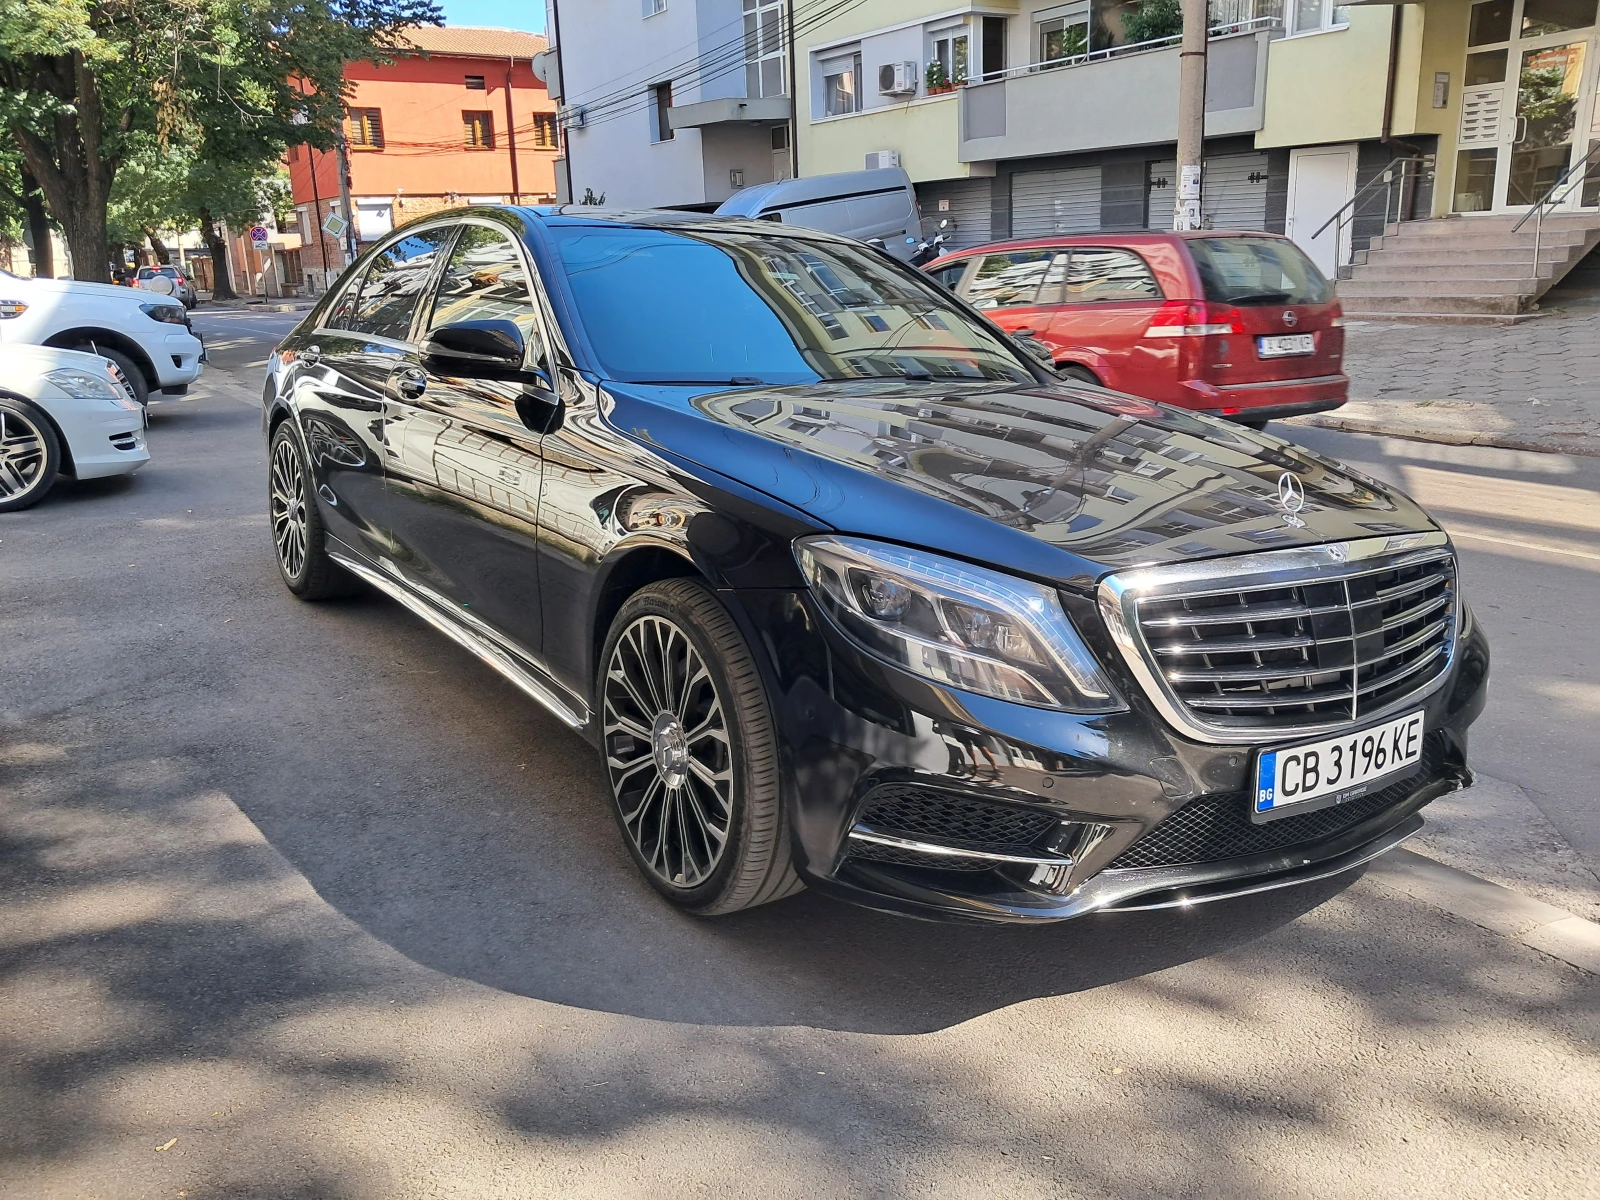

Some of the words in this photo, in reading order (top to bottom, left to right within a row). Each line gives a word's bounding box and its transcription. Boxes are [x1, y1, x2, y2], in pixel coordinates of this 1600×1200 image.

[1281, 751, 1320, 797] CB
[1326, 731, 1386, 786] 3196
[1391, 718, 1420, 765] KE
[1259, 788, 1273, 802] BG
